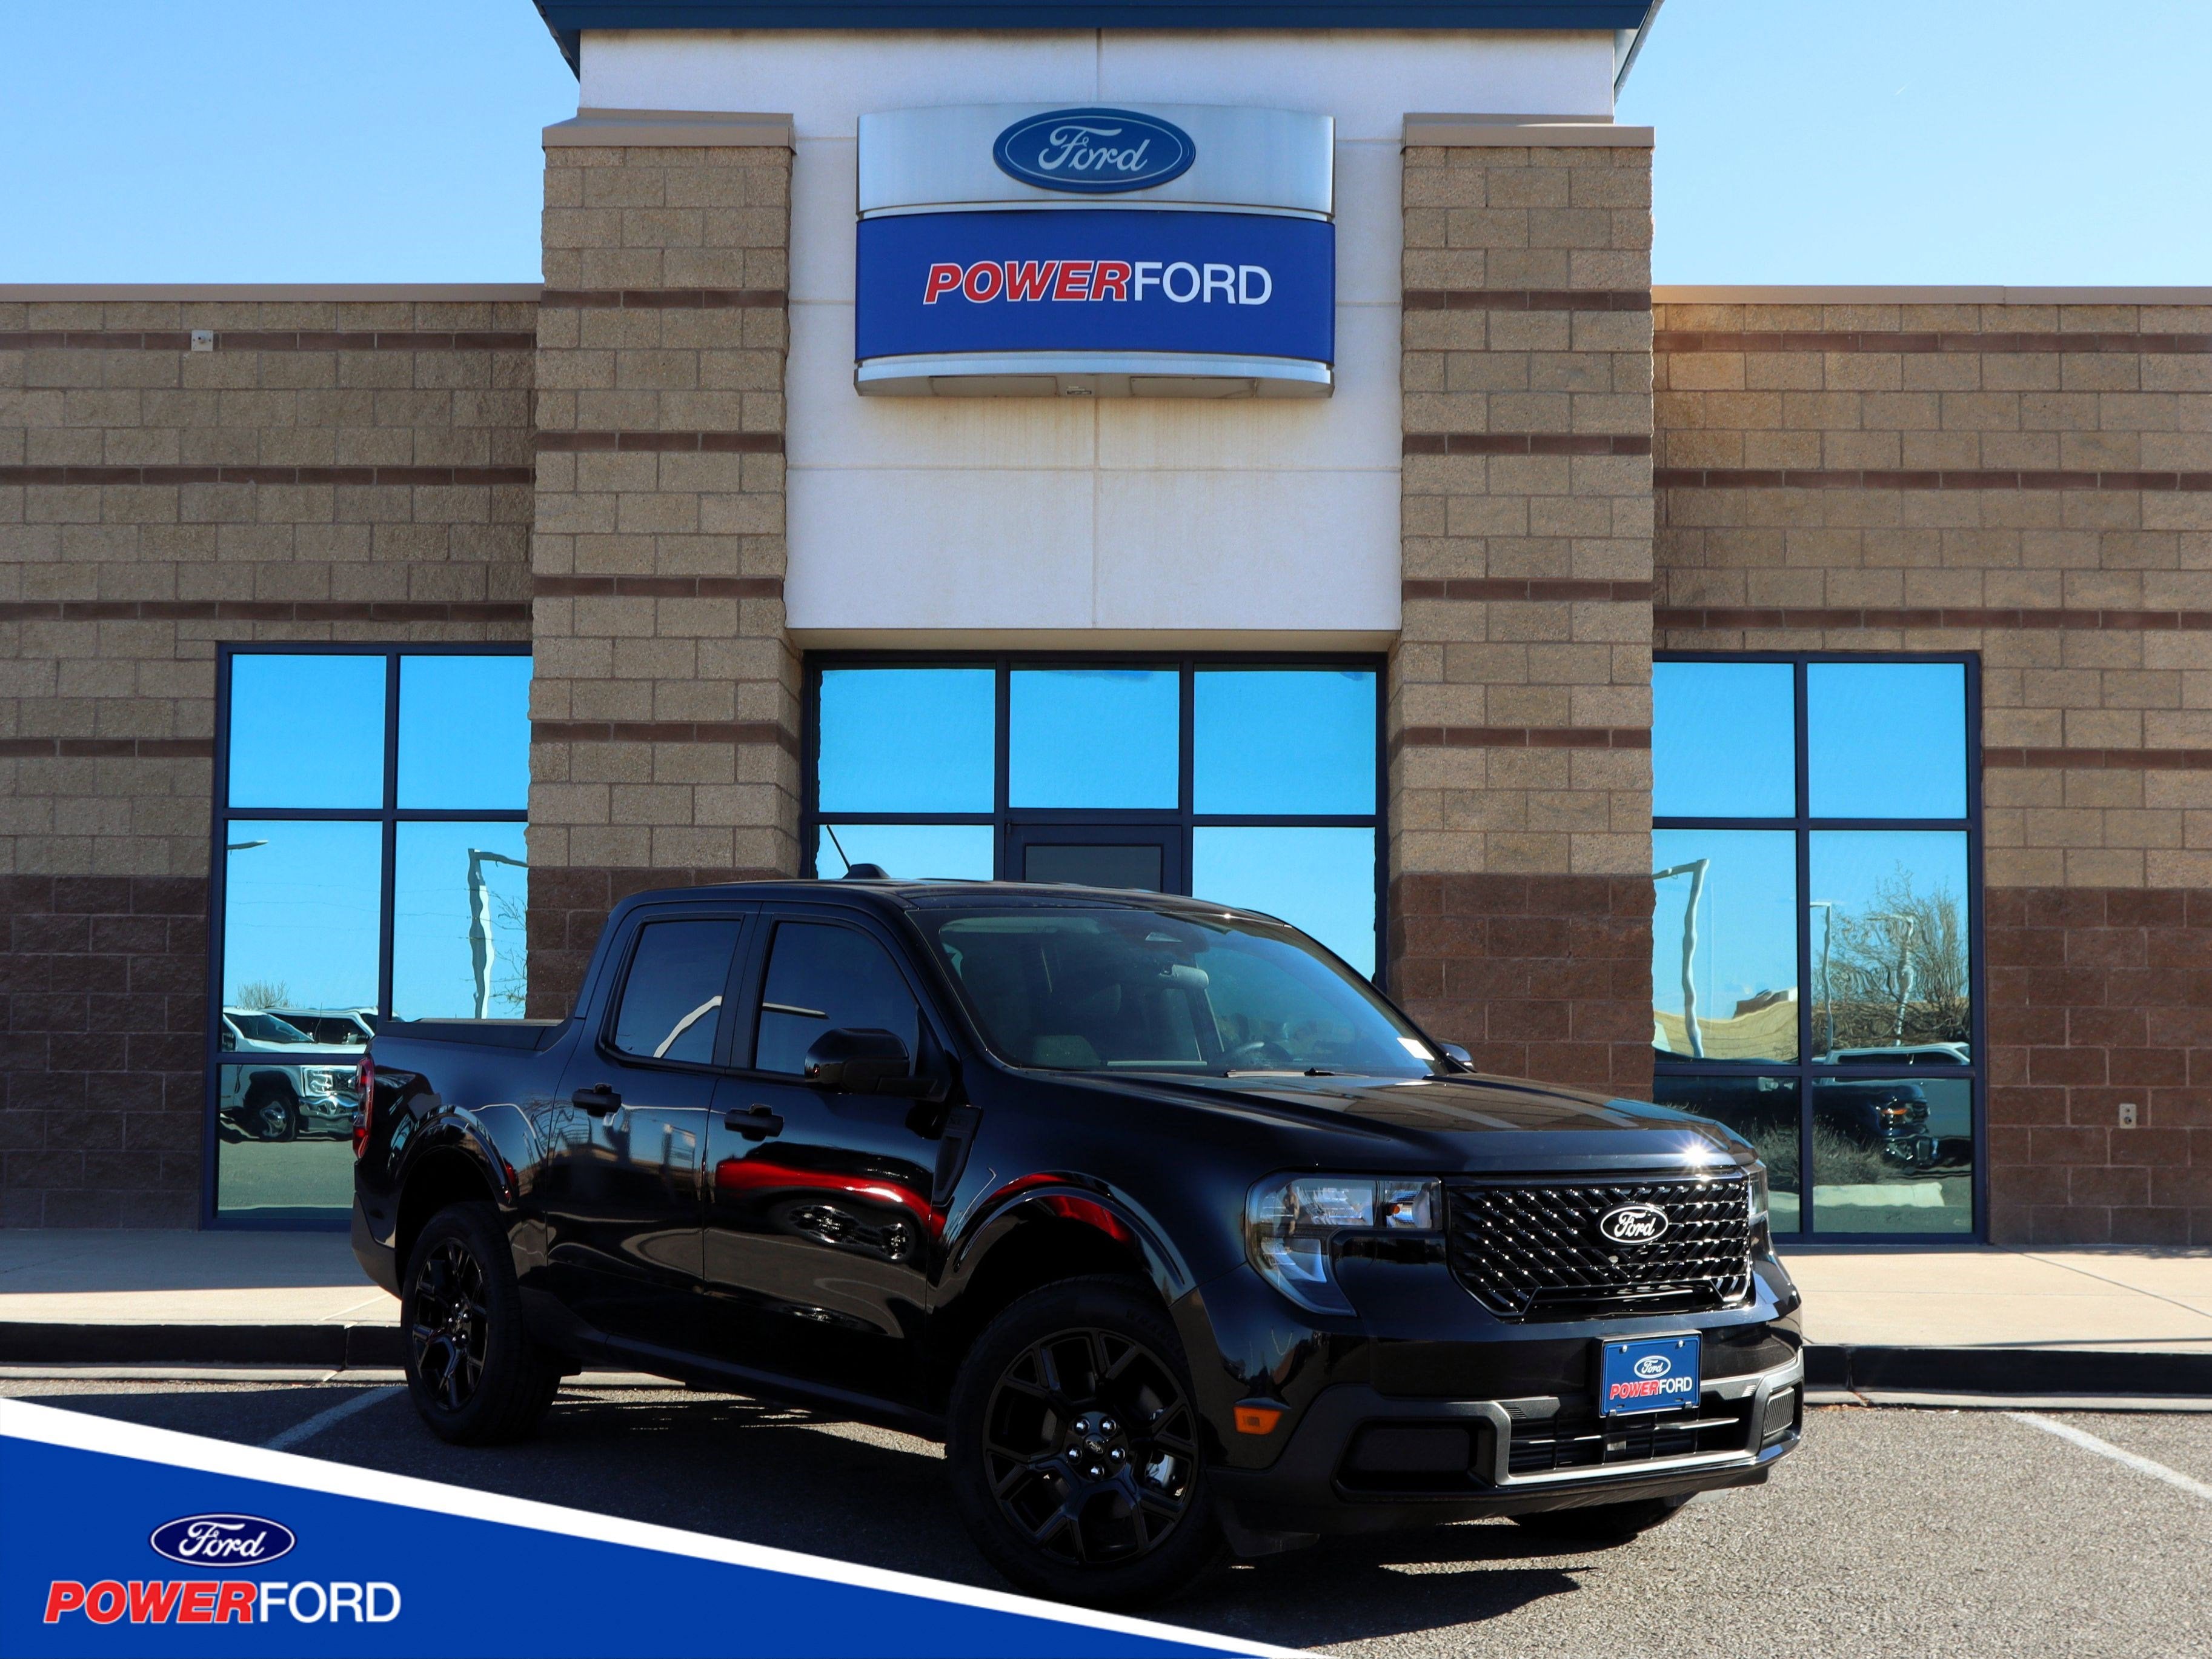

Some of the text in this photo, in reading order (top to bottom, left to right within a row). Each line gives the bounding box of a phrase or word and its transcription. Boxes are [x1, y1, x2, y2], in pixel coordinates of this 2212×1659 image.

[1038, 124, 1151, 172] Ford
[923, 260, 1272, 305] POWERFORD
[1614, 1211, 1656, 1238] Ford
[1641, 1359, 1663, 1373] Ford
[1609, 1377, 1692, 1400] POWERFORD
